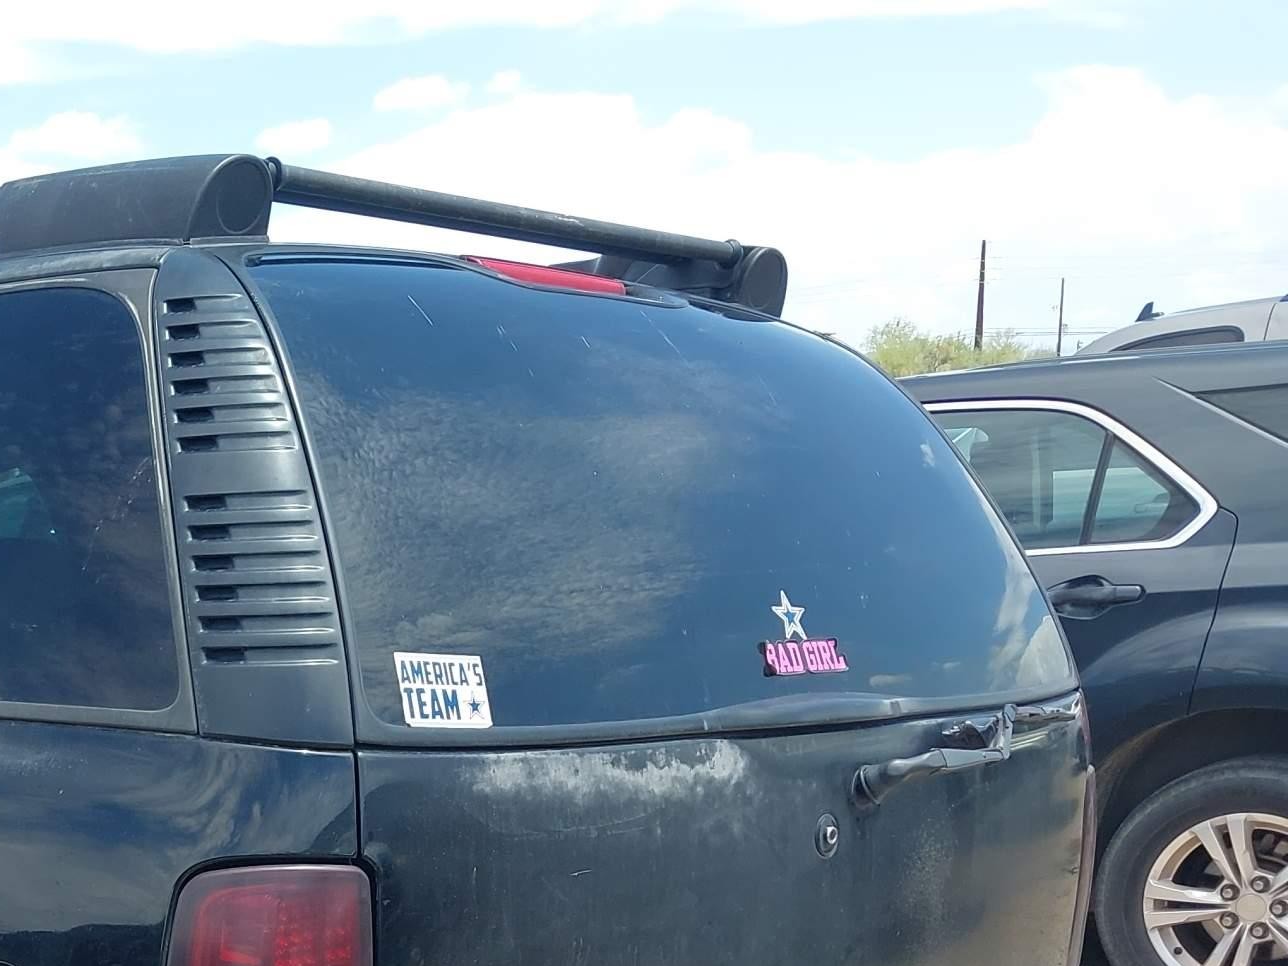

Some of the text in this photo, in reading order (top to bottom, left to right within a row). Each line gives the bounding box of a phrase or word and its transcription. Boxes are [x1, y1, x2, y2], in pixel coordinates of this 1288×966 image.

[400, 660, 483, 686] AMERICA'S
[765, 639, 848, 674] BAD GIRL
[403, 687, 461, 720] TEAM
